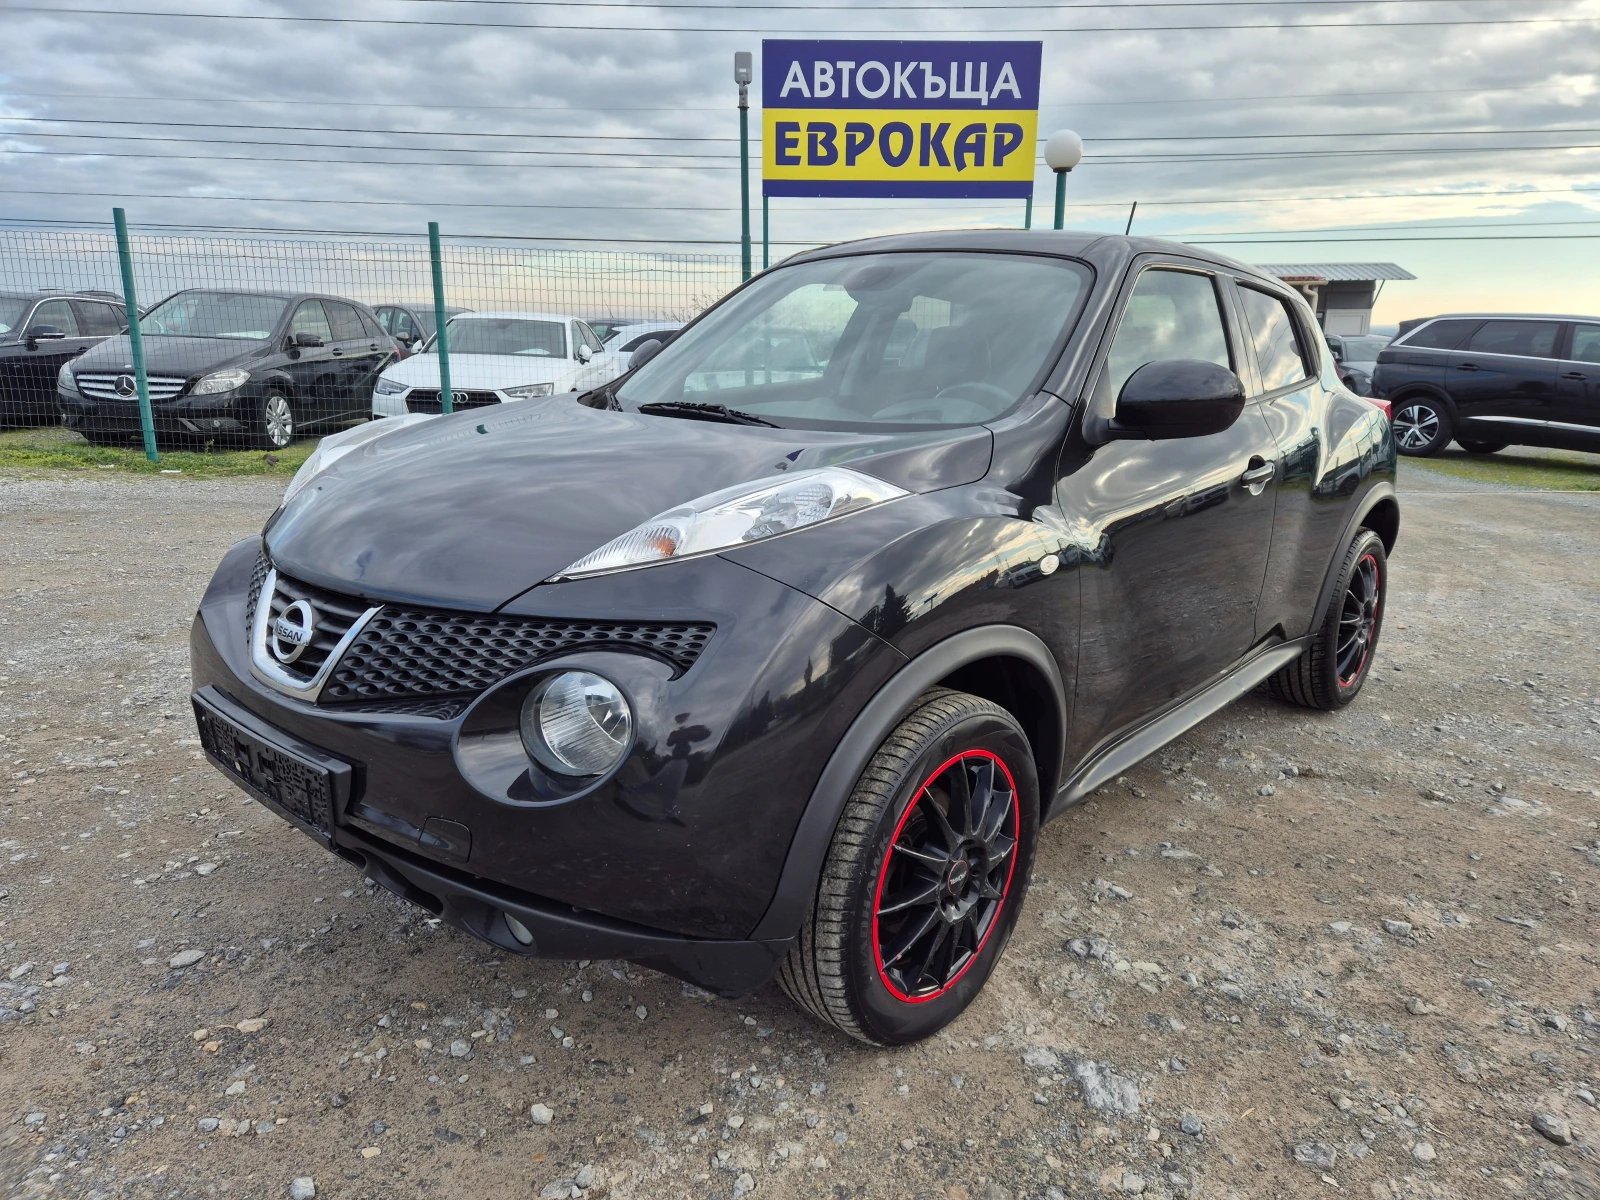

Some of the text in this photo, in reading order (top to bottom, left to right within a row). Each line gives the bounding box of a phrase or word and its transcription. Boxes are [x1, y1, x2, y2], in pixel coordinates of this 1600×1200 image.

[779, 60, 1022, 106] АВТОКЪЩА
[775, 121, 1024, 172] ЕВРОКАР
[275, 624, 303, 641] SSAN
